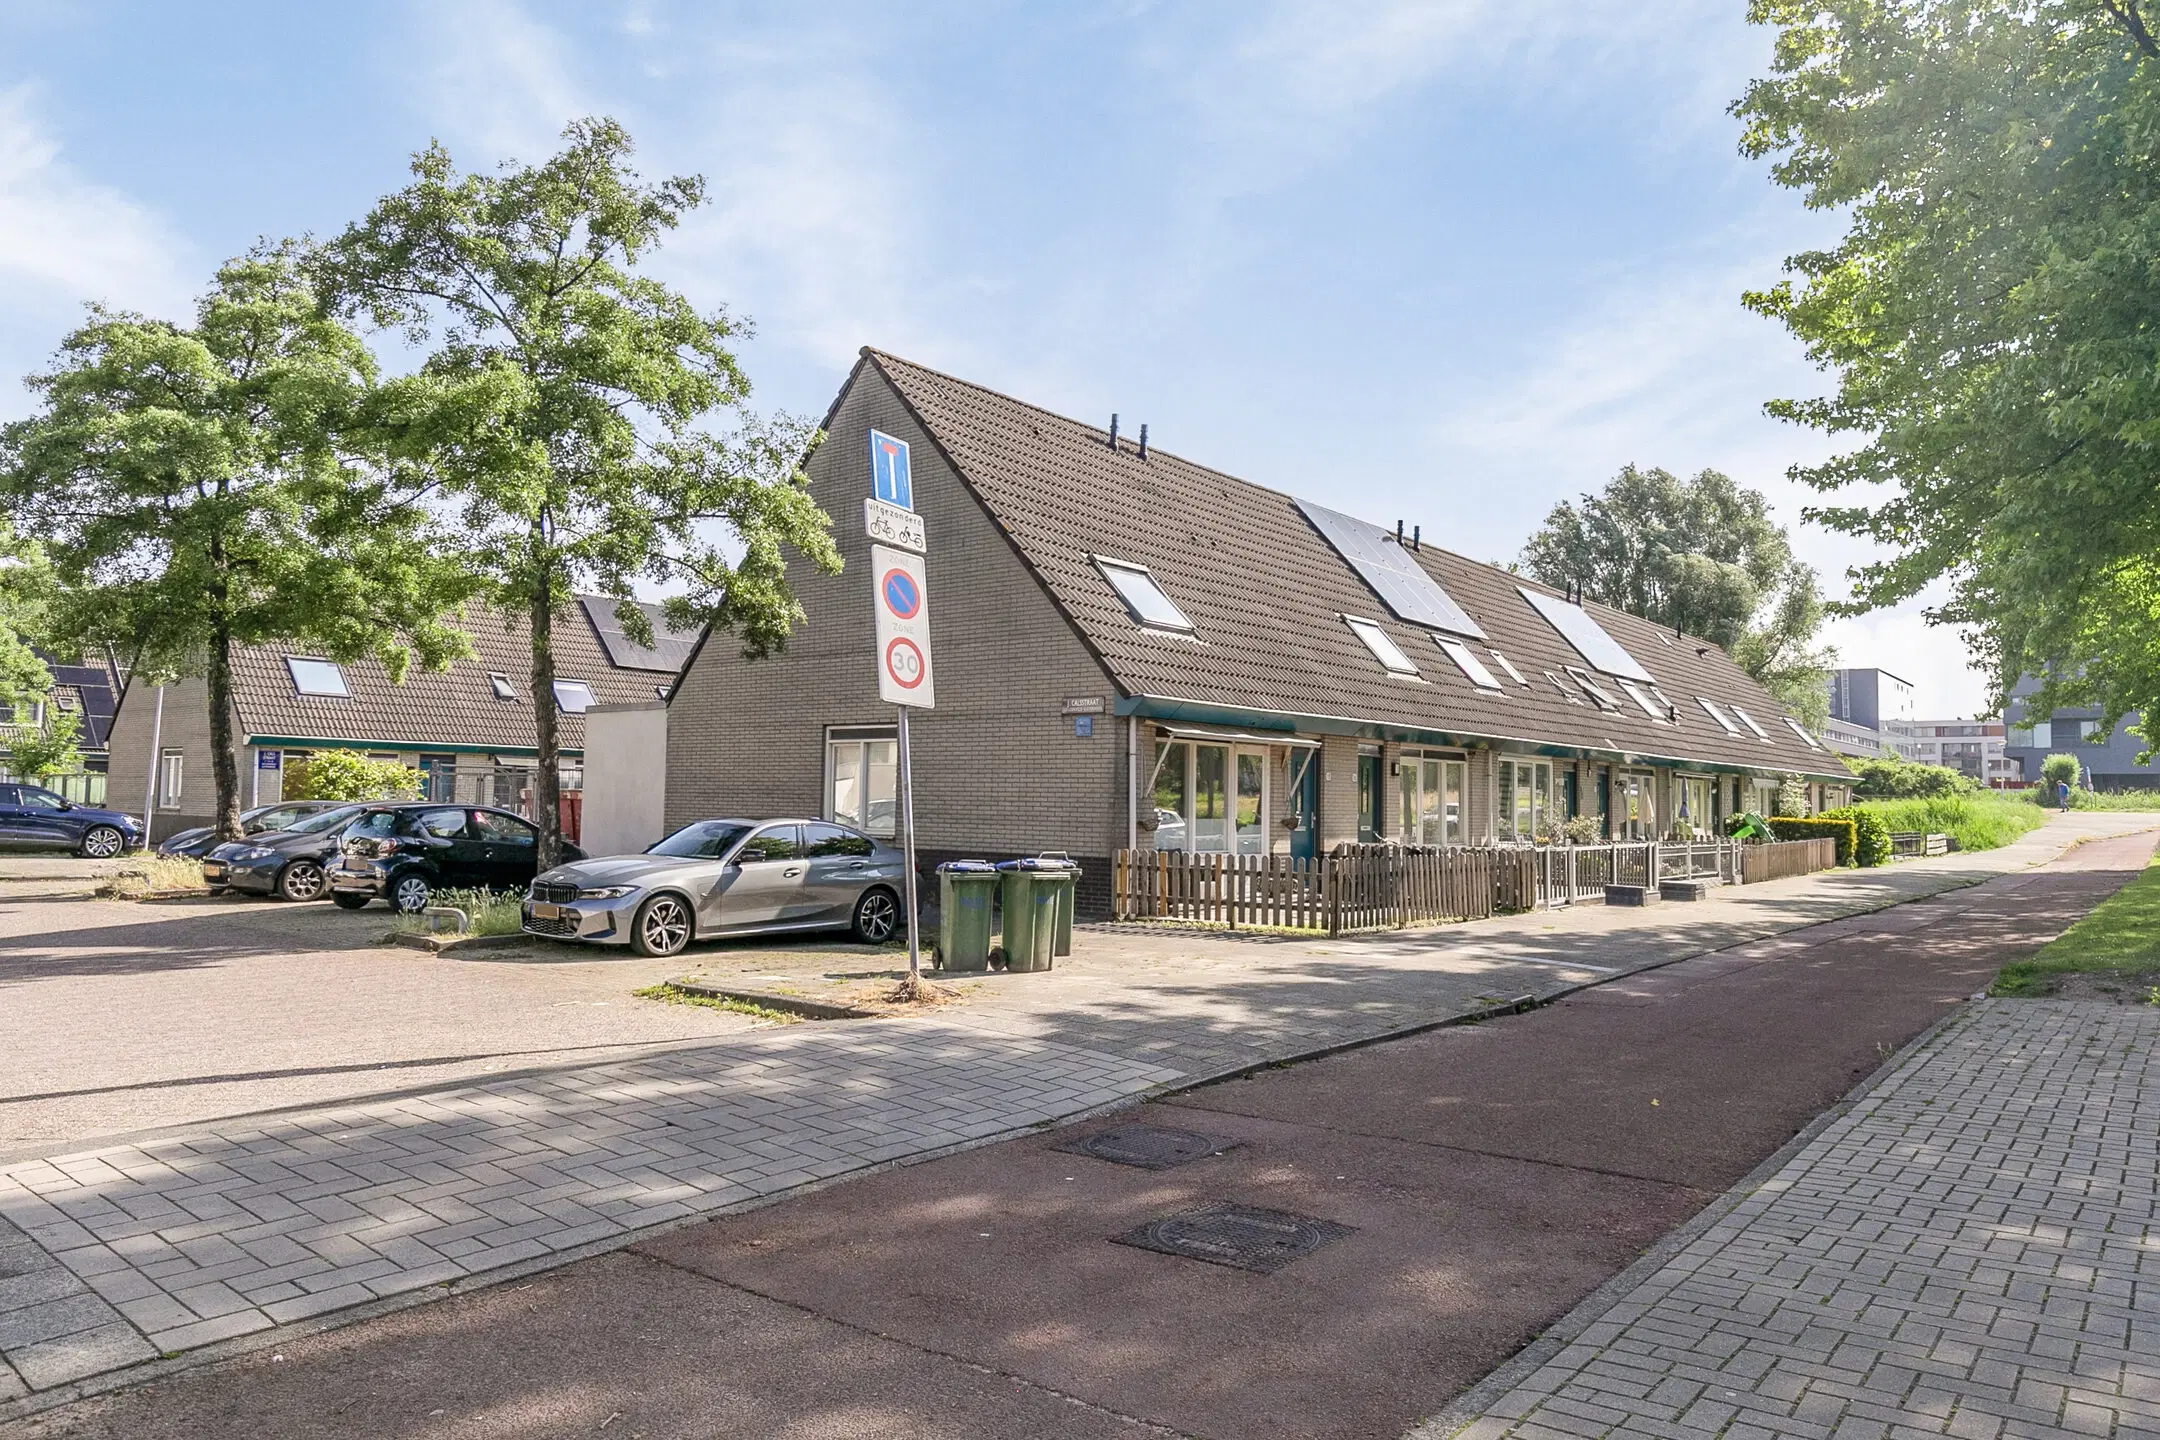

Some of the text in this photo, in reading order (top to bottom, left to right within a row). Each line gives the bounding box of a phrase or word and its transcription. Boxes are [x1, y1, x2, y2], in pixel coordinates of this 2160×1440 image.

[868, 503, 922, 527] uitgezonderd
[889, 554, 911, 568] ZONE
[892, 622, 915, 635] ZONE
[893, 652, 918, 674] 30
